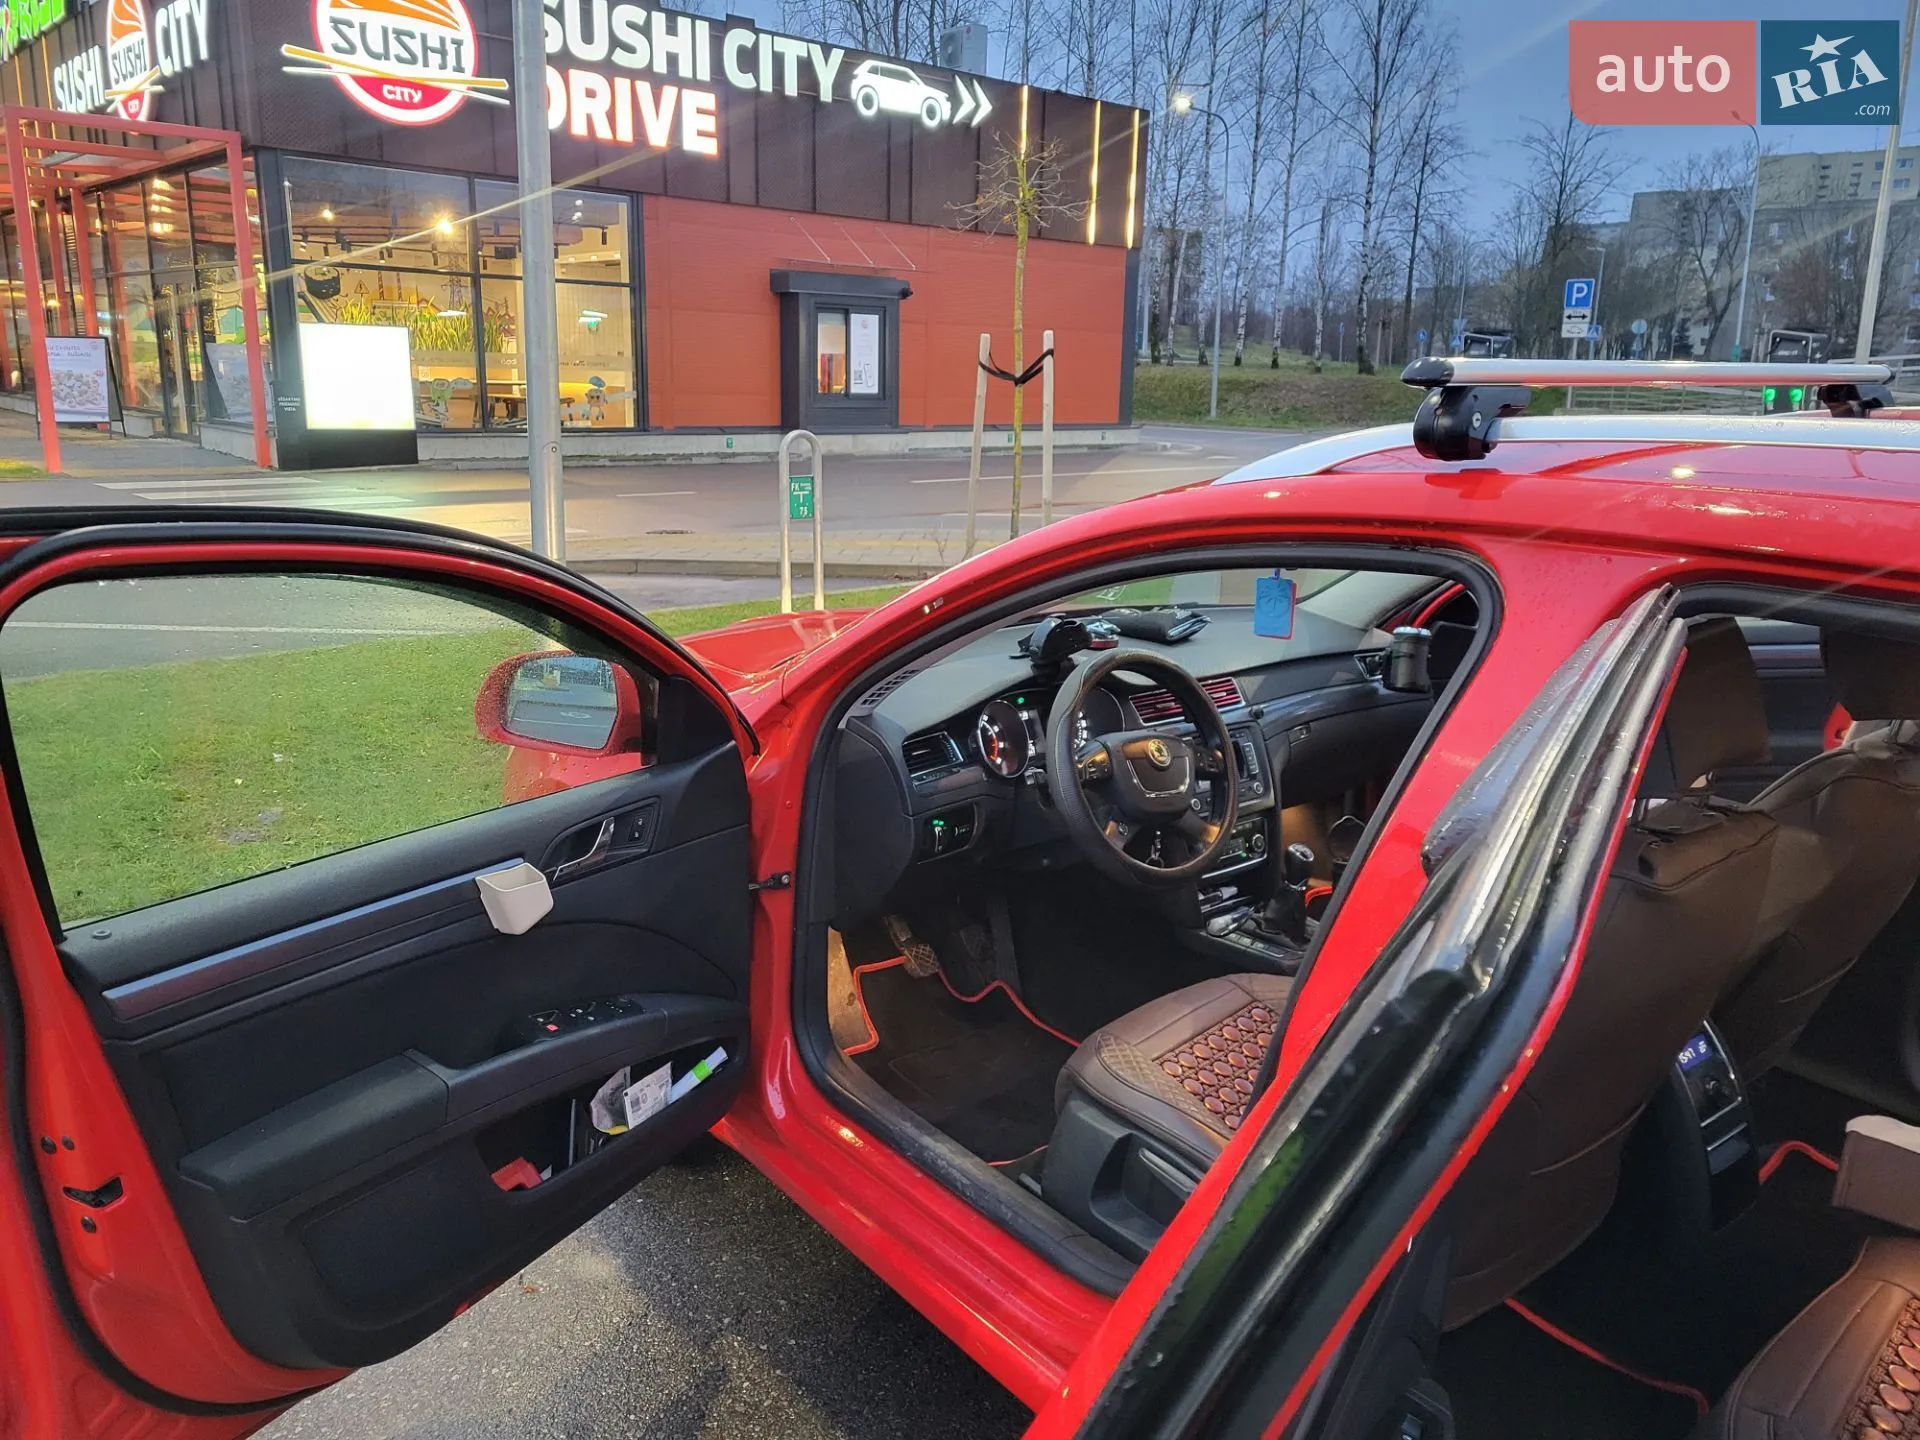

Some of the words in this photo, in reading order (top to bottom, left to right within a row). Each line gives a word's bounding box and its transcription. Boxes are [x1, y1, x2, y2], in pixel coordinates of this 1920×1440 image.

[54, 45, 107, 112] SUSHI
[155, 0, 209, 77] CITY
[111, 38, 148, 84] SUSHI
[329, 15, 465, 74] SUSHI
[723, 28, 845, 103] CITY
[382, 84, 423, 103] CITY
[1571, 282, 1589, 306] P
